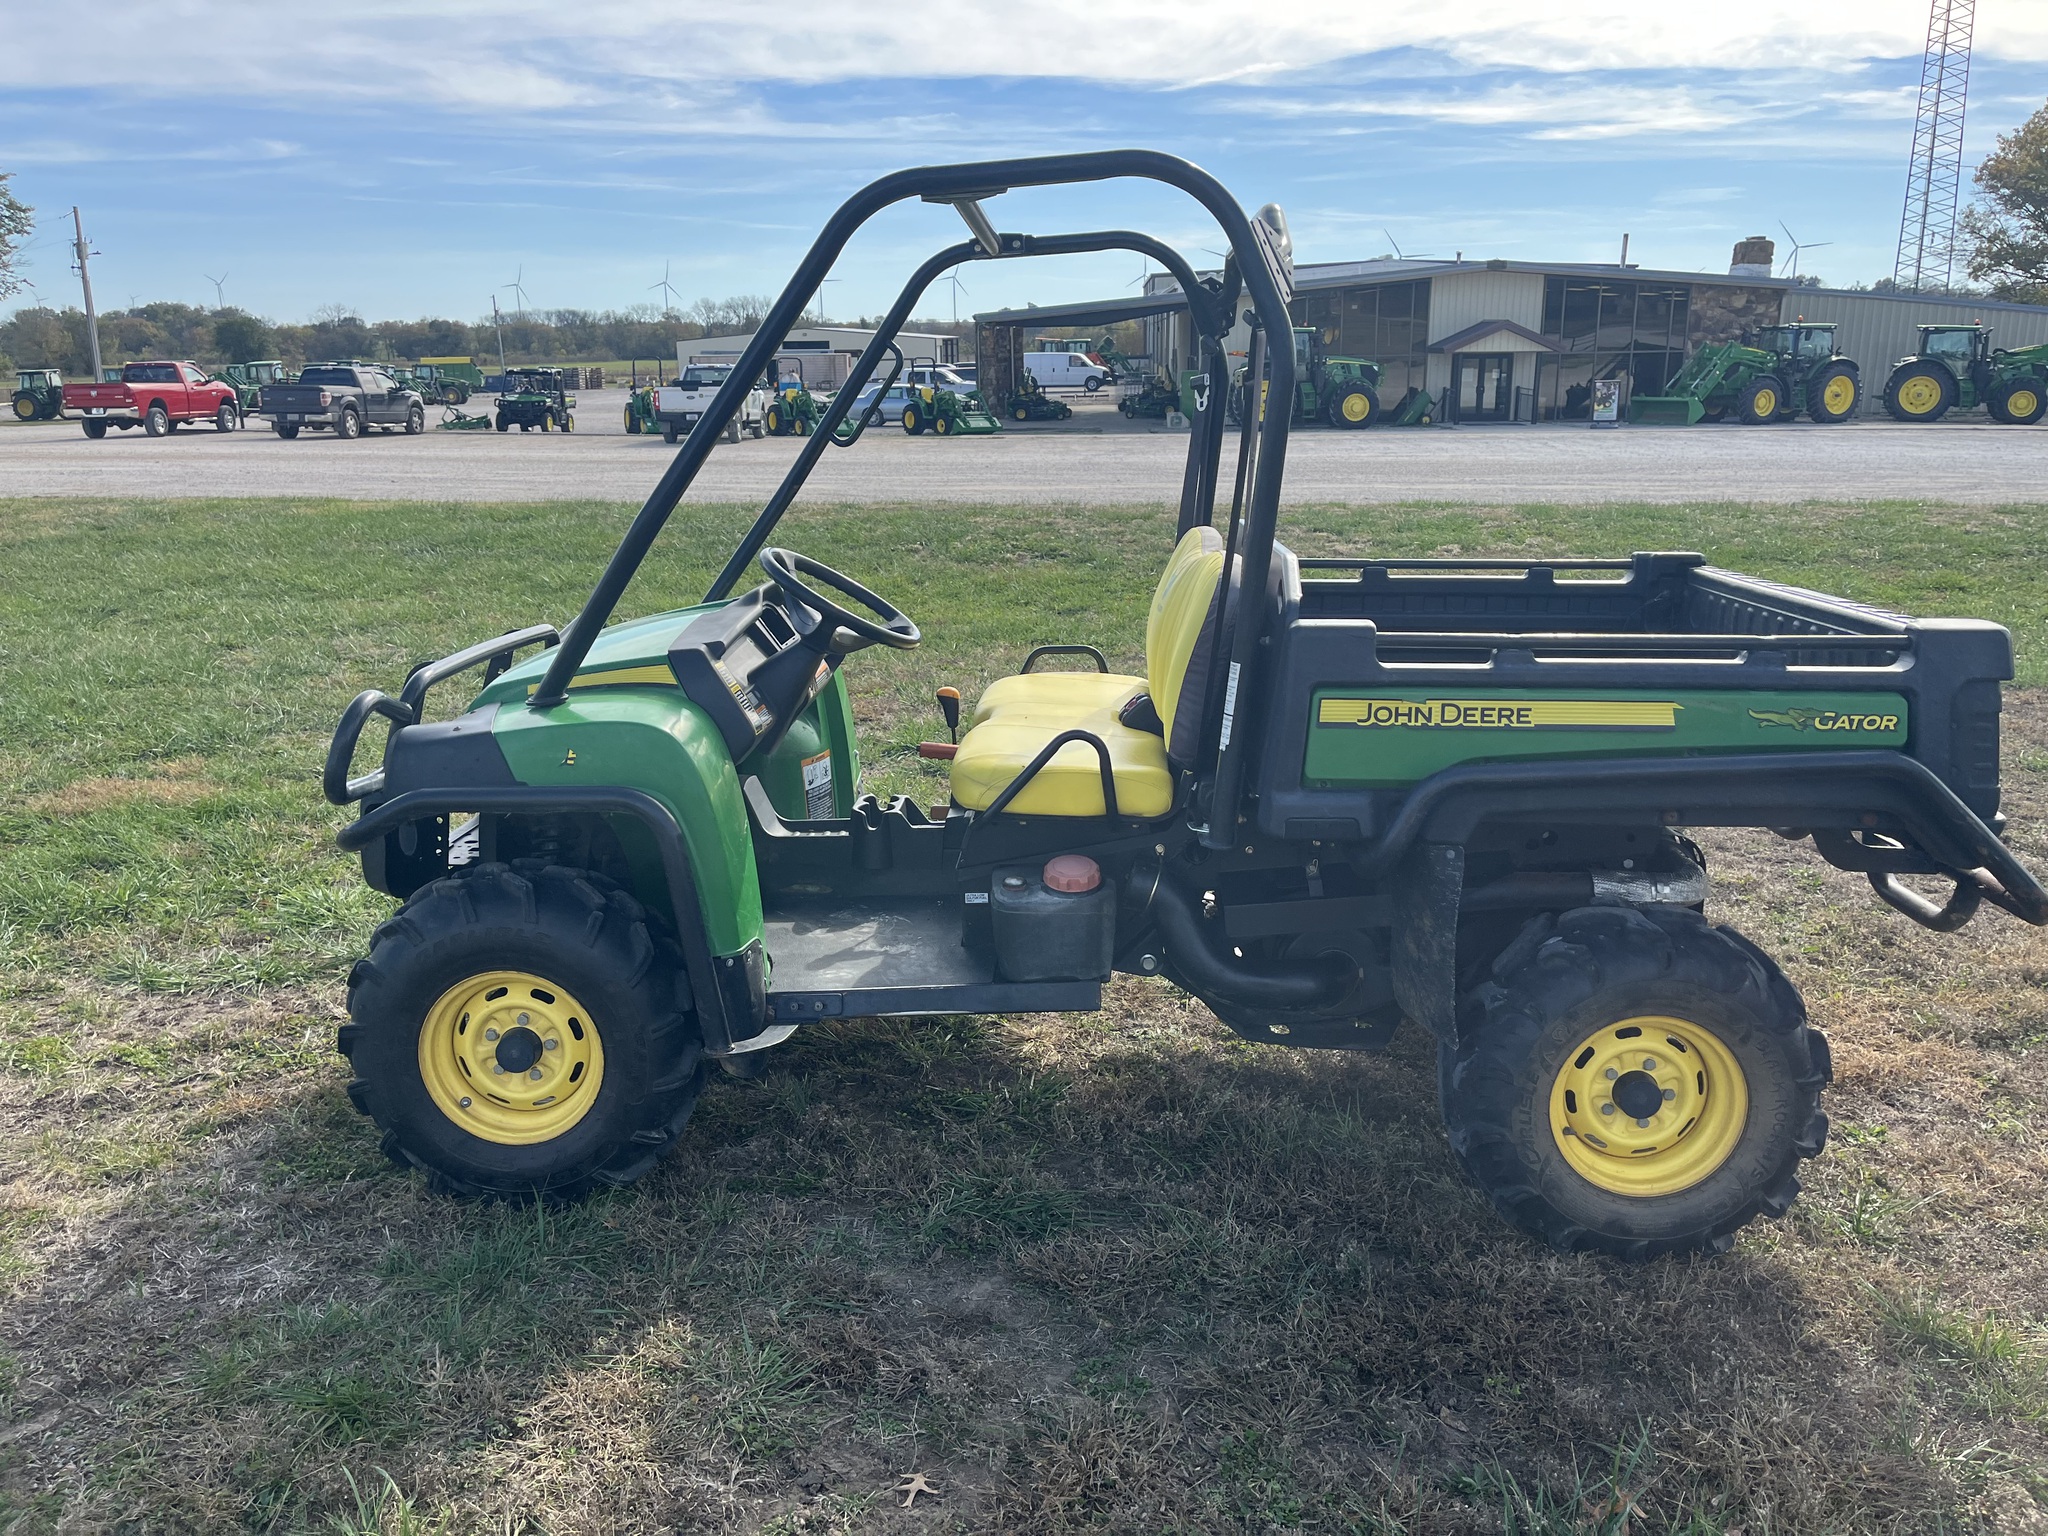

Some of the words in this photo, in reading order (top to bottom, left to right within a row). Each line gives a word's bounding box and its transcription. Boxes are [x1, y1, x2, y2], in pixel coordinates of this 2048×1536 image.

[1356, 702, 1433, 724] JOHN
[1440, 702, 1533, 725] DEERE
[1814, 711, 1899, 731] GATOR
